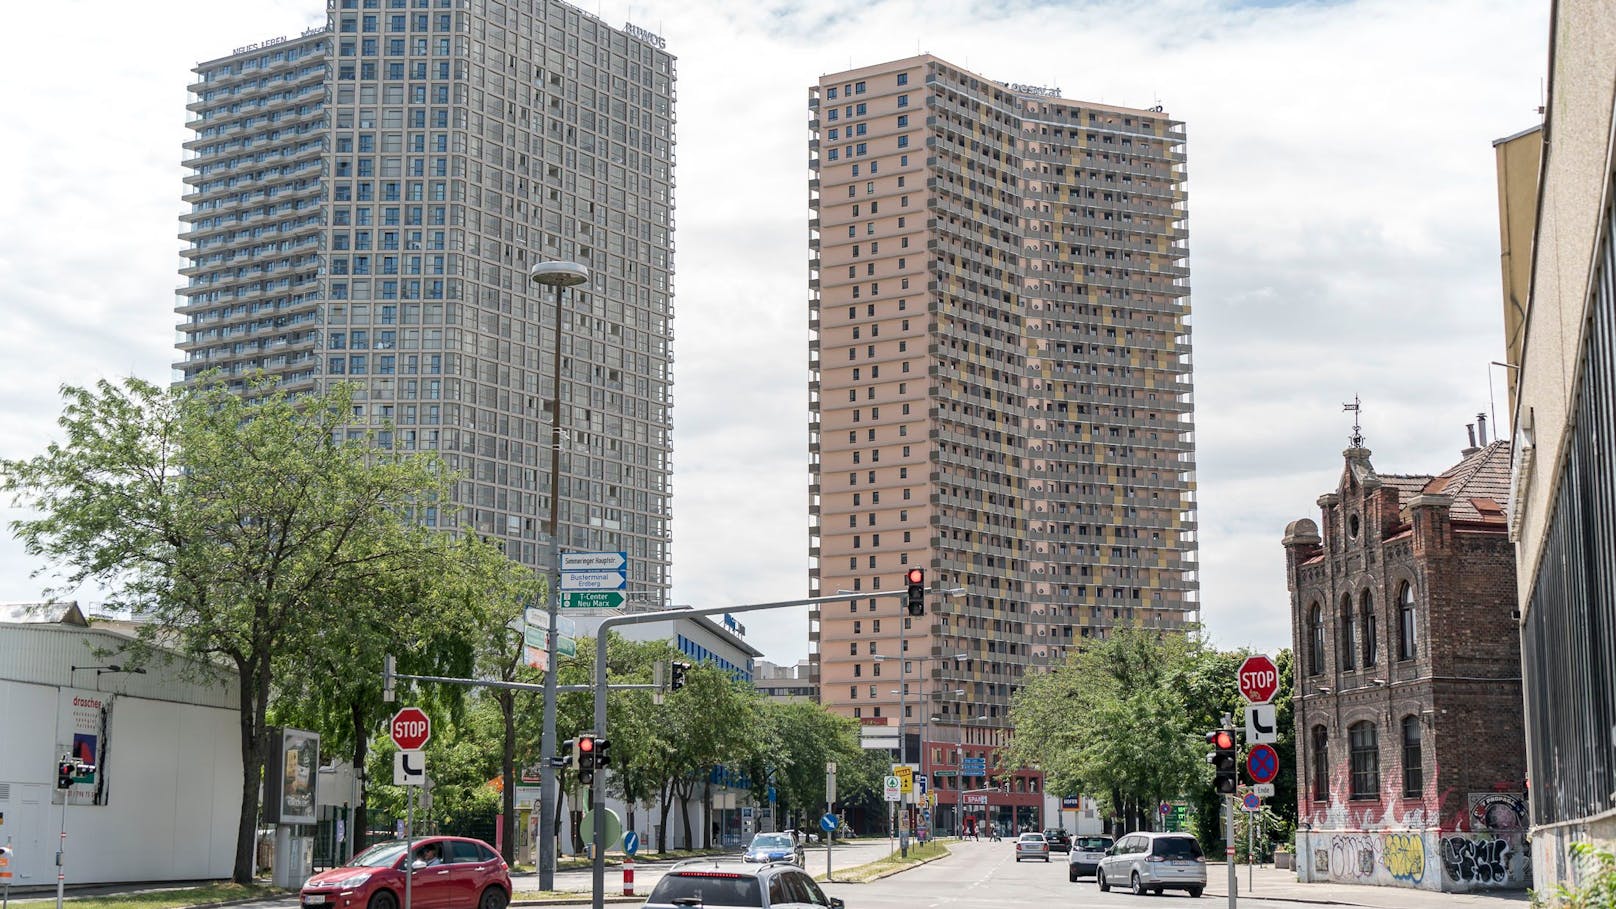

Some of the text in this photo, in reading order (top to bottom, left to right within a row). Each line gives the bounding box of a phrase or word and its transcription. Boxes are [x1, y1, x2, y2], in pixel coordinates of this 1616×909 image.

[232, 35, 287, 55] NEUES LEBEN
[625, 21, 666, 49] BUWOG
[1242, 670, 1275, 690] STOP
[395, 720, 426, 738] STOP
